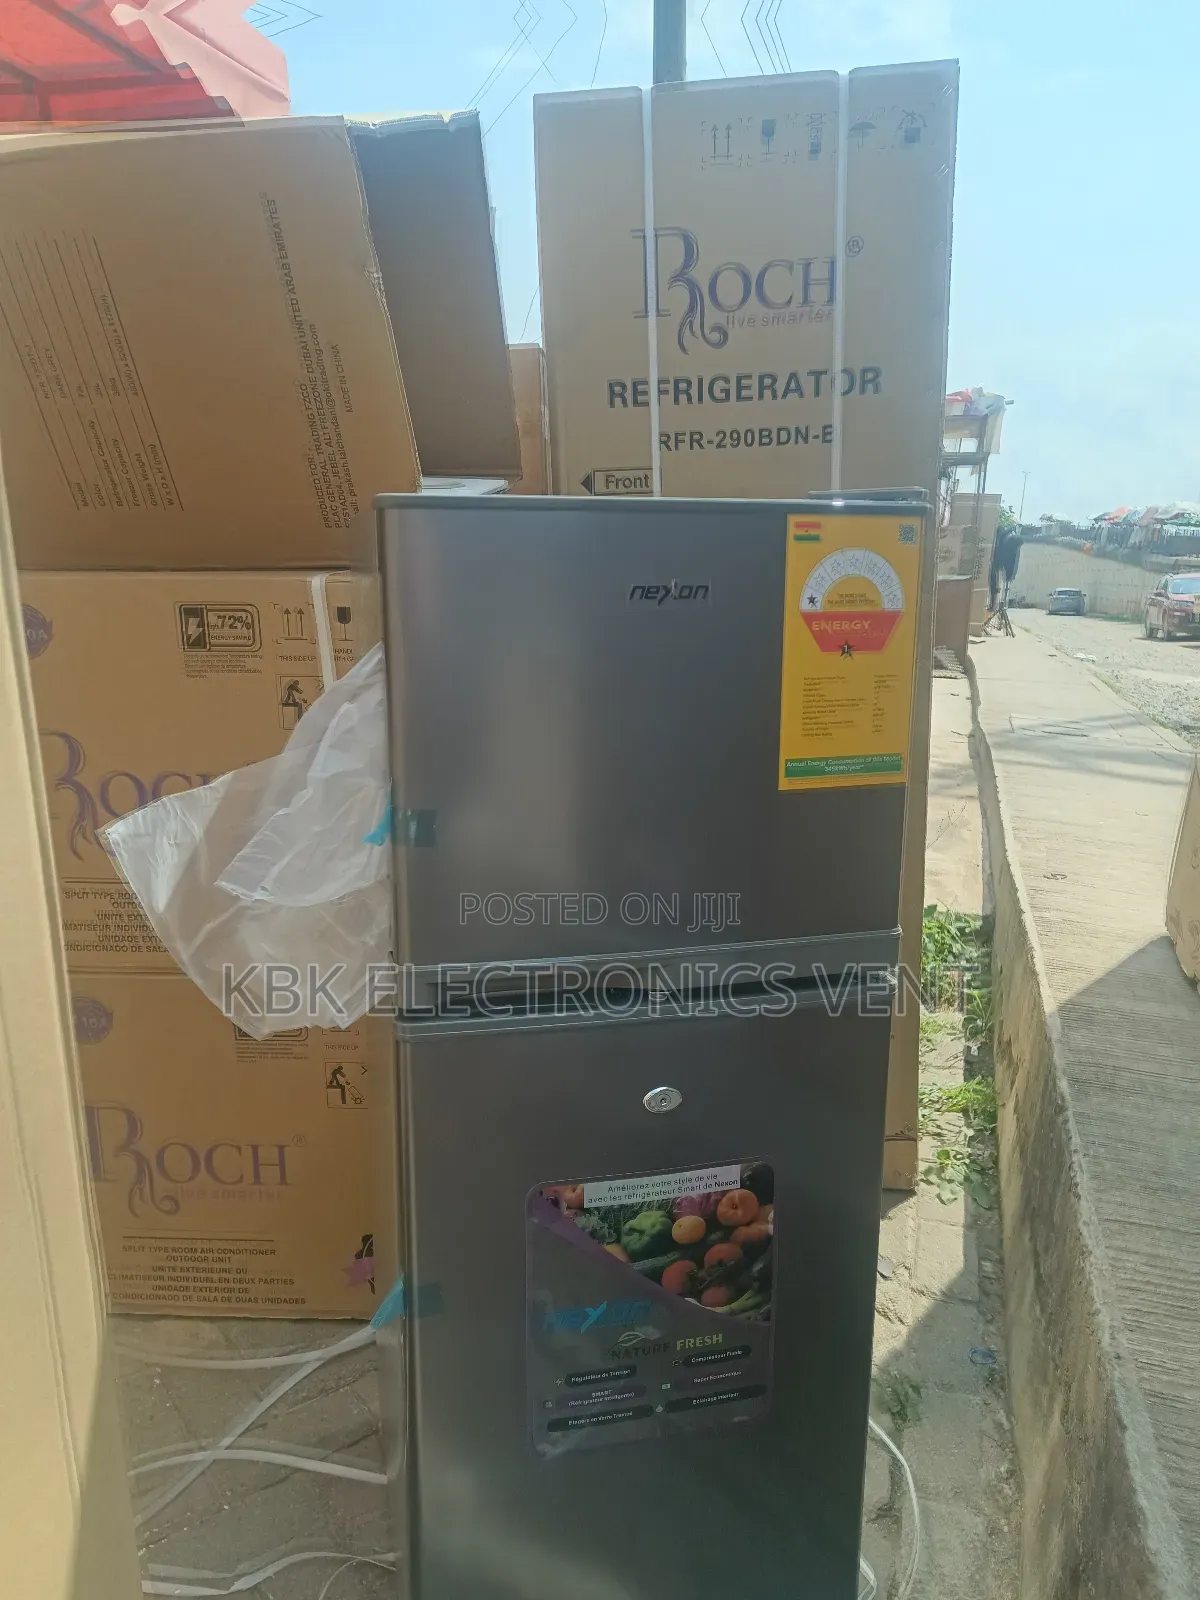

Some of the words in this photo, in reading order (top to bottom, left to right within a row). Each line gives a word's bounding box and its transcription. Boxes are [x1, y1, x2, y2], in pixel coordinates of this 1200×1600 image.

[267, 199, 289, 260] EMIRATES
[282, 263, 297, 295] ARAB
[290, 298, 306, 338] UNITED
[726, 312, 757, 330] live
[300, 340, 315, 373] DUBAI
[332, 343, 345, 373] CHINA
[338, 375, 347, 385] IN
[607, 366, 882, 408] REFRIGERATOR
[300, 383, 314, 411] FZCO
[309, 376, 329, 430] FREEZONE
[341, 386, 354, 413] MADE
[308, 412, 324, 455] TRADING
[323, 432, 334, 448] ALI
[112, 438, 129, 475] Capacity
[135, 453, 149, 481] Weight
[308, 453, 319, 476] FOR:
[328, 450, 341, 480] JEBEL
[126, 476, 141, 507] Freezer
[319, 459, 336, 503] GENERAL
[604, 473, 651, 490] Front
[75, 482, 89, 507] Model
[93, 483, 106, 507] Color
[145, 482, 158, 507] Gross
[313, 478, 333, 529] PRODUCED
[329, 504, 343, 529] PLAC
[217, 615, 252, 630] 72%
[811, 619, 872, 634] ENERGY
[786, 760, 807, 768] Annual
[807, 759, 828, 768] Energy
[828, 757, 865, 766] Consumption
[64, 891, 90, 900] SPLIT
[92, 891, 116, 900] TYPE
[118, 892, 139, 900] ROO
[112, 901, 144, 910] OUTDO
[64, 923, 111, 932] MATISEUR
[114, 924, 155, 933] INDIVIDU
[97, 913, 124, 921] UNITE
[64, 944, 128, 953] ONDICIONADO
[131, 945, 144, 953] DE
[97, 935, 139, 943] UNIDADE
[587, 1196, 608, 1204] avec
[609, 1194, 622, 1202] les
[624, 1187, 676, 1201] réfrigérateur
[677, 1184, 701, 1193] Smart
[702, 1182, 713, 1190] de
[714, 1179, 738, 1188] Nexon
[608, 1183, 650, 1194] Améliorez
[651, 1180, 672, 1189] votre
[673, 1177, 693, 1188] style
[694, 1174, 705, 1183] de
[706, 1172, 719, 1181] vie
[122, 1245, 145, 1253] SPLIT
[148, 1246, 169, 1254] TYPE
[171, 1246, 198, 1254] ROOM
[200, 1247, 214, 1255] AIR
[216, 1248, 276, 1256] CONDITIONER
[166, 1255, 209, 1263] OUTDOOR
[108, 1273, 165, 1282] CLIMATISEUR
[218, 1276, 230, 1284] EN
[232, 1277, 256, 1285] DEUX
[152, 1265, 177, 1273] UNITE
[179, 1266, 233, 1274] EXTERIEURE
[235, 1267, 248, 1275] DU
[112, 1292, 180, 1301] CONDICIONADO
[182, 1294, 193, 1302] DE
[196, 1295, 220, 1303] SALA
[235, 1296, 259, 1304] DUAS
[261, 1297, 306, 1305] UNIDADES
[152, 1285, 191, 1293] UNIDADE
[193, 1286, 236, 1294] EXTERIOR
[676, 1333, 724, 1351] FRESH
